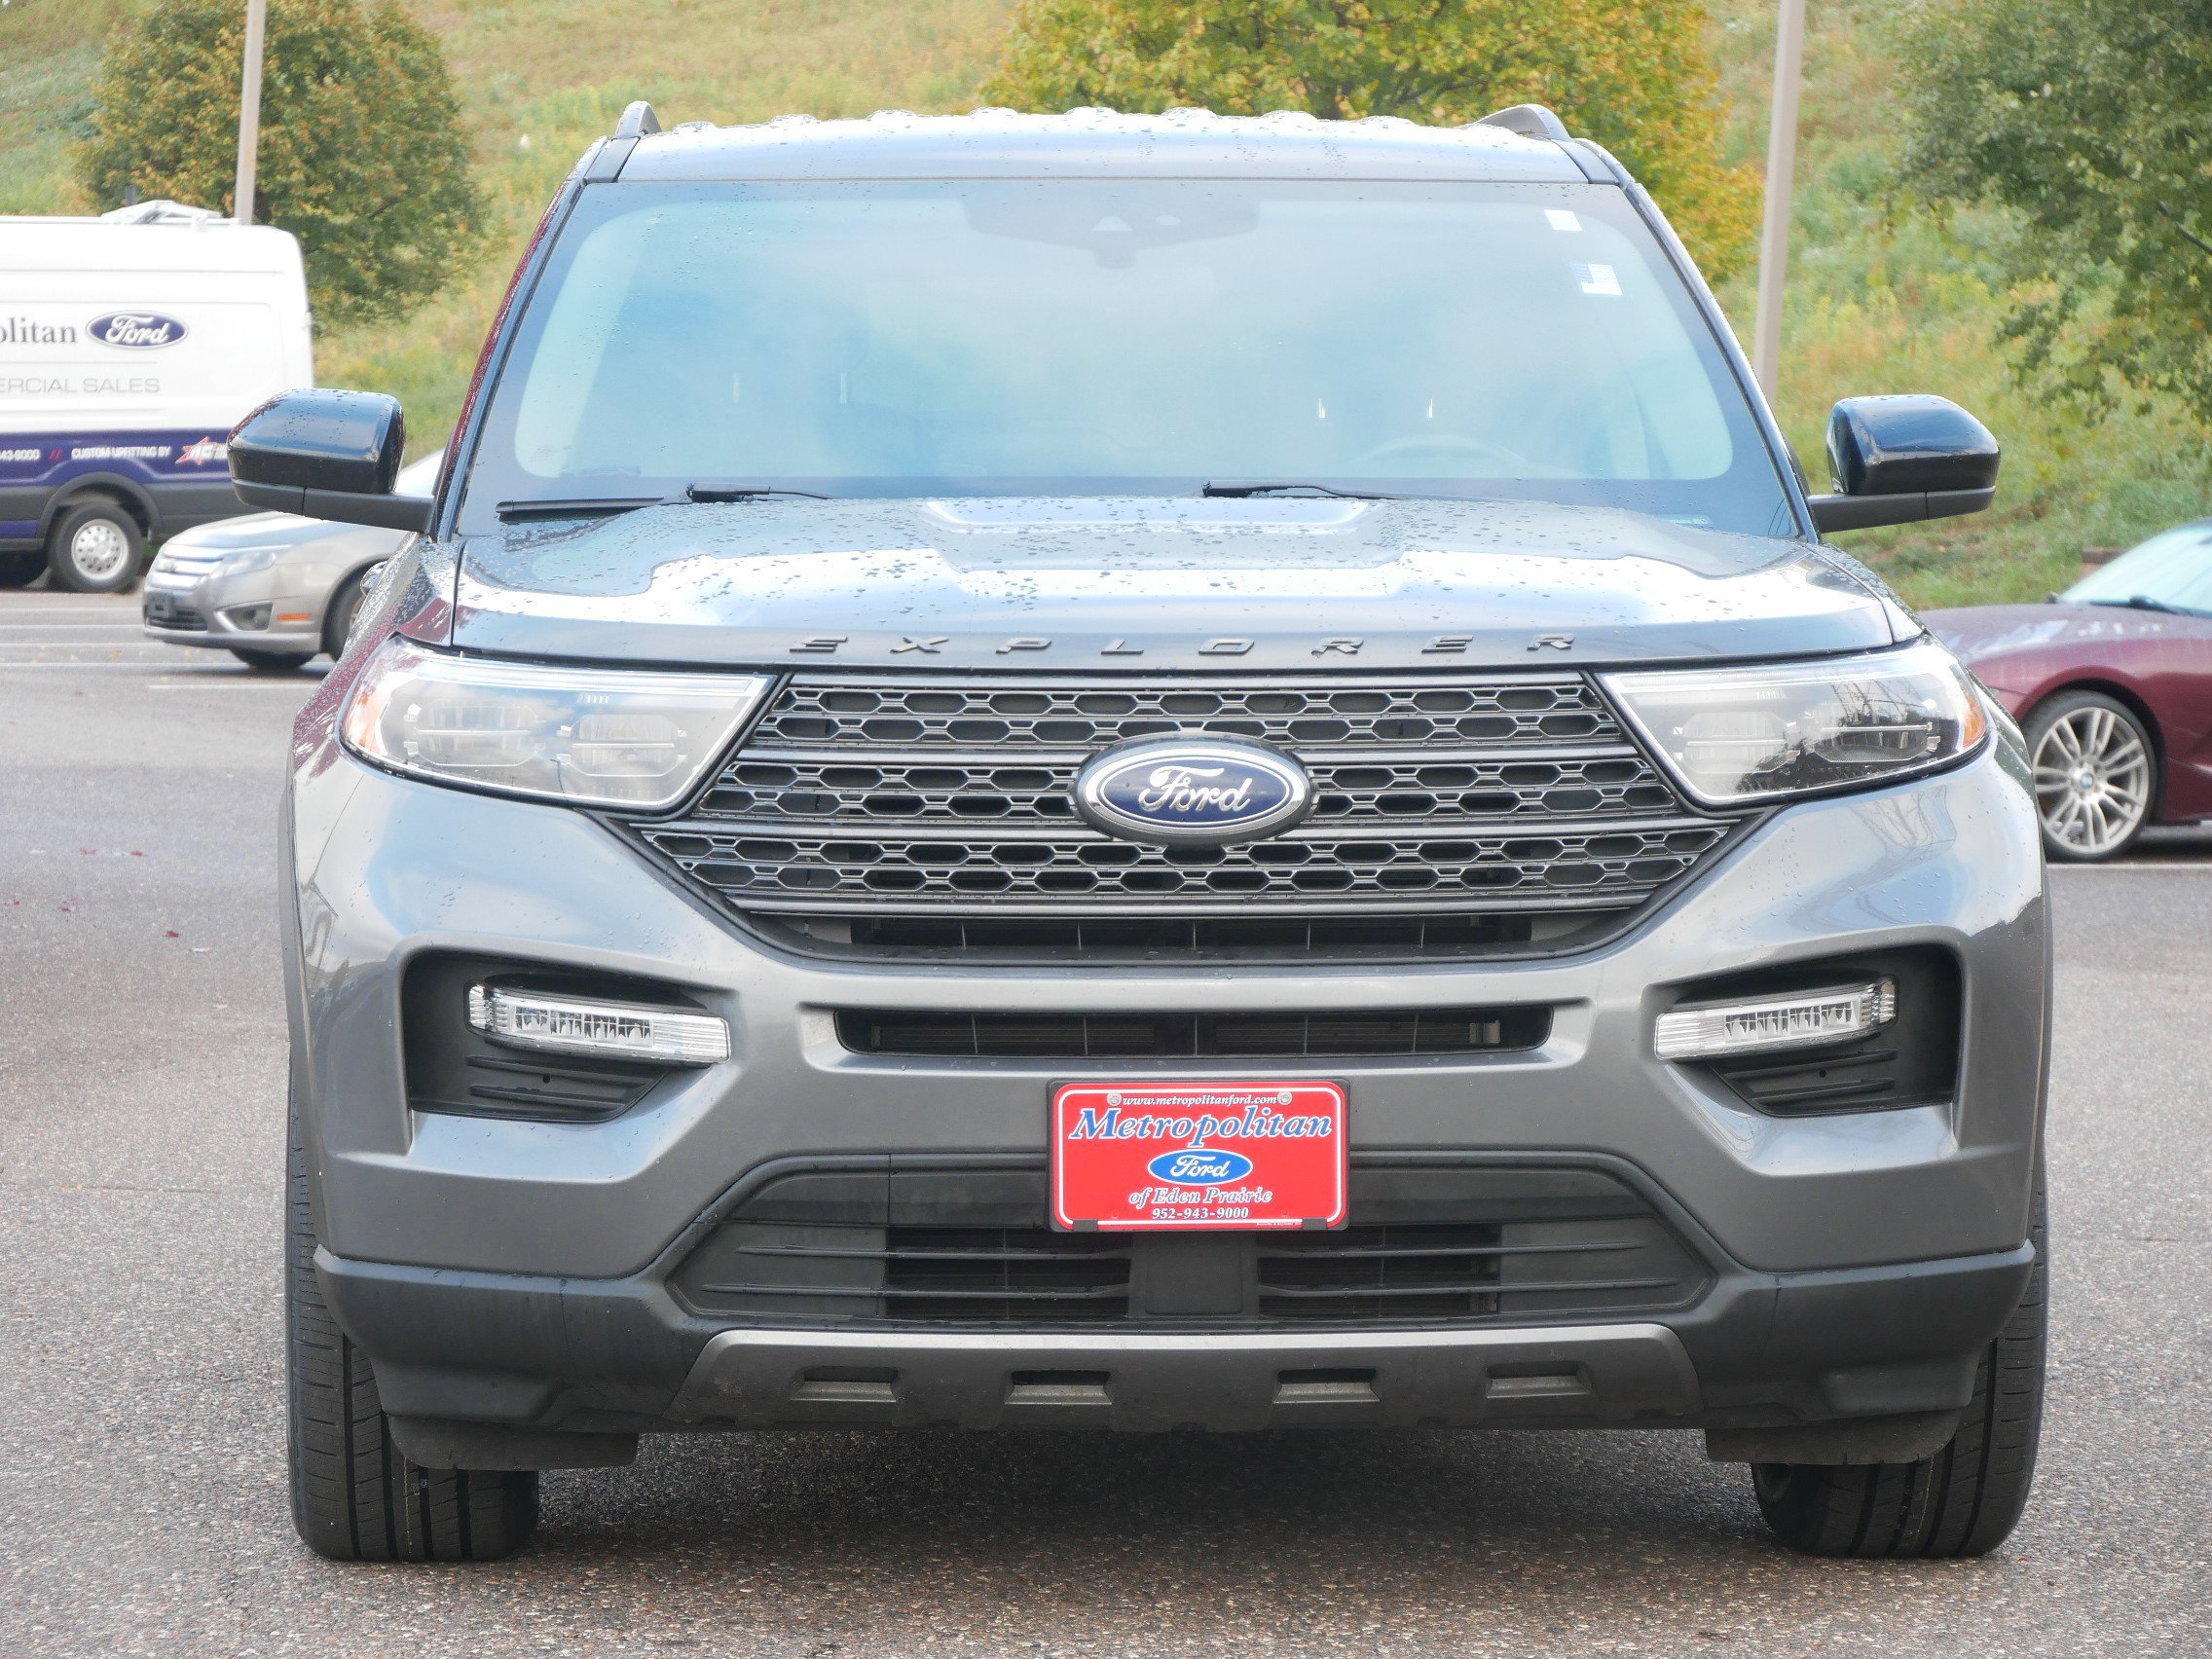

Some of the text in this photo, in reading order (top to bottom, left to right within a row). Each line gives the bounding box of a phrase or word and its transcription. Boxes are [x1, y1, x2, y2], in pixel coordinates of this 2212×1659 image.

[104, 314, 170, 345] Ford
[83, 377, 161, 393] SALES
[71, 446, 111, 460] CUSTOM
[158, 445, 171, 458] BY
[790, 631, 1575, 656] EXPLORER
[1137, 765, 1252, 813] Ford
[1123, 1093, 1277, 1108] www.metropolitanford.com
[1068, 1105, 1333, 1148] Metropolitan
[1169, 1154, 1230, 1178] Ford
[1128, 1186, 1273, 1209] of Eden Prairie
[1152, 1206, 1250, 1220] 952-943-9000
